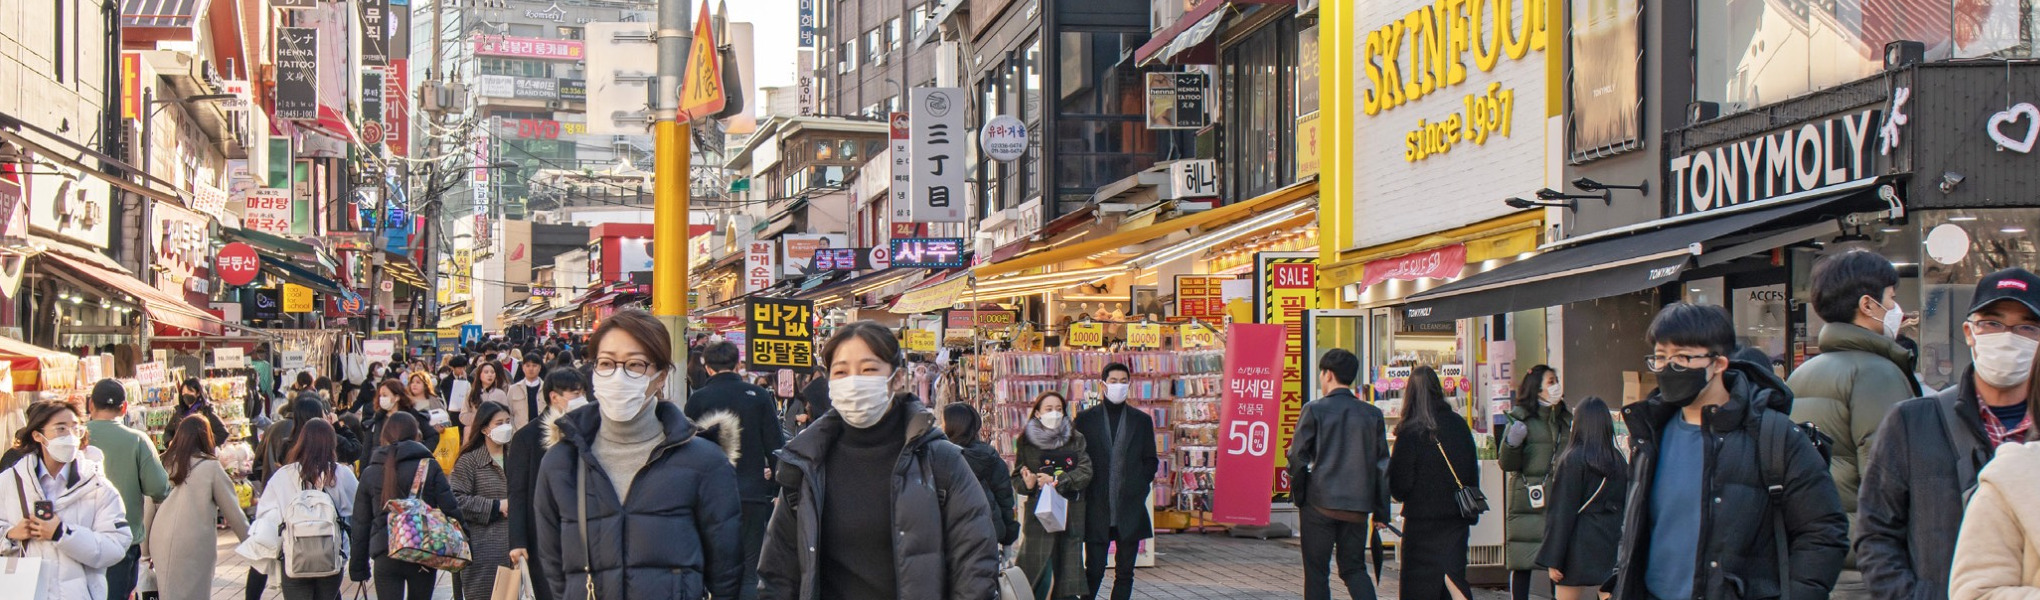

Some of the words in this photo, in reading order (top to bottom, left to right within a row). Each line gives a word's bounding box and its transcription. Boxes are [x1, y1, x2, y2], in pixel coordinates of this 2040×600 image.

[279, 49, 314, 57] HENNA
[518, 118, 560, 139] DVD
[1405, 112, 1462, 163] since
[1463, 81, 1514, 146] 1957
[1670, 109, 1876, 215] TONYMOLY
[1185, 161, 1216, 193] 헤나
[246, 196, 289, 210] 마라탕
[245, 218, 288, 232] 쌀국수
[896, 241, 957, 263] 사주
[219, 256, 256, 271] 부동산
[750, 243, 770, 294] 할매순대
[1649, 264, 1681, 281] TONYMOLY
[1280, 266, 1309, 286] SALE
[753, 304, 811, 338] 반값
[1407, 307, 1432, 317] TONYMOLY
[1419, 322, 1452, 330] CLEANSING
[1073, 332, 1099, 342] 10000
[1130, 333, 1156, 344] 10000
[1185, 333, 1210, 345] 5000
[754, 341, 810, 365] 방탈출
[1231, 378, 1274, 399] 빅세일
[1237, 403, 1264, 416] 전품목
[1227, 420, 1270, 457] 50
